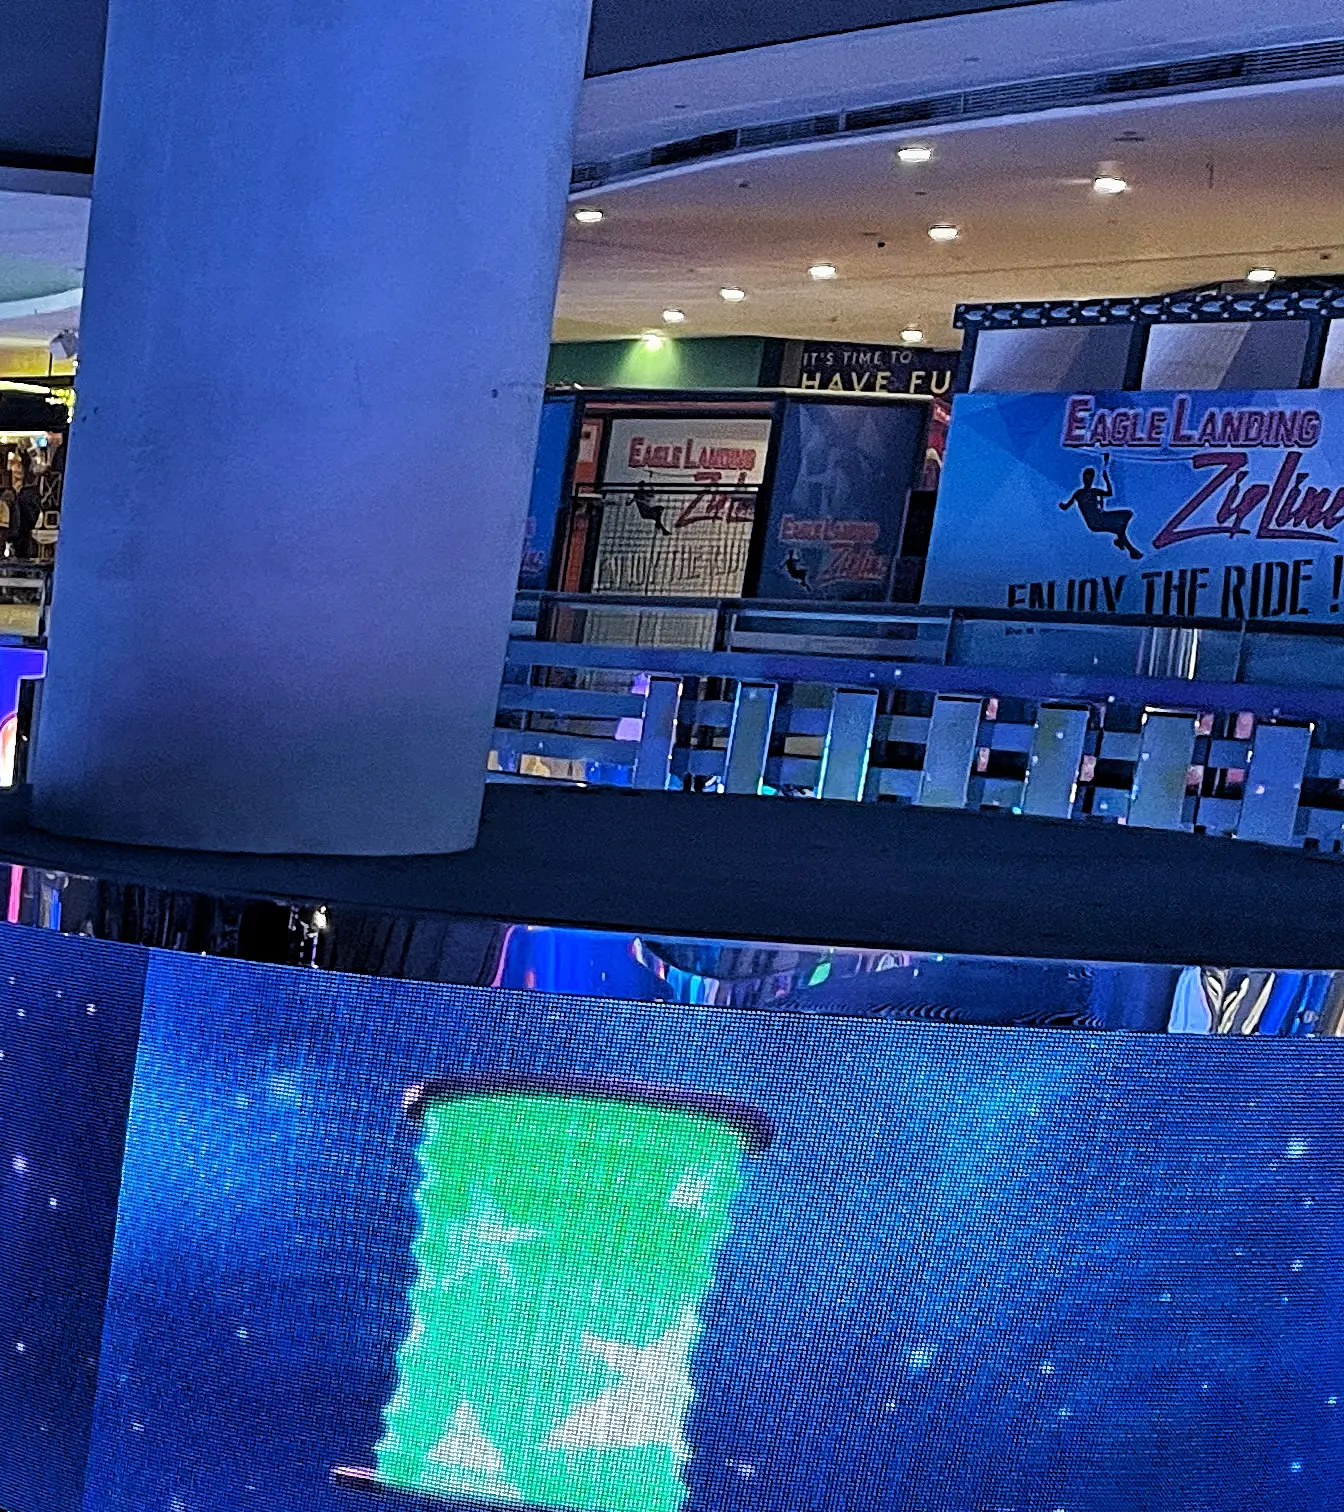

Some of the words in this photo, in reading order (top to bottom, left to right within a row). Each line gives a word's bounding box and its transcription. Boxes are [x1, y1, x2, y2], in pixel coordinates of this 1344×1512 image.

[802, 351, 834, 366] IT'S
[842, 351, 882, 366] TIME
[890, 351, 913, 366] TO
[800, 370, 893, 393] HAVE
[1062, 395, 1168, 448] EAGLE
[1168, 395, 1322, 449] LANDING
[1007, 574, 1127, 611] ENJOY
[1141, 567, 1210, 616] THE
[1220, 558, 1314, 618] RIDE
